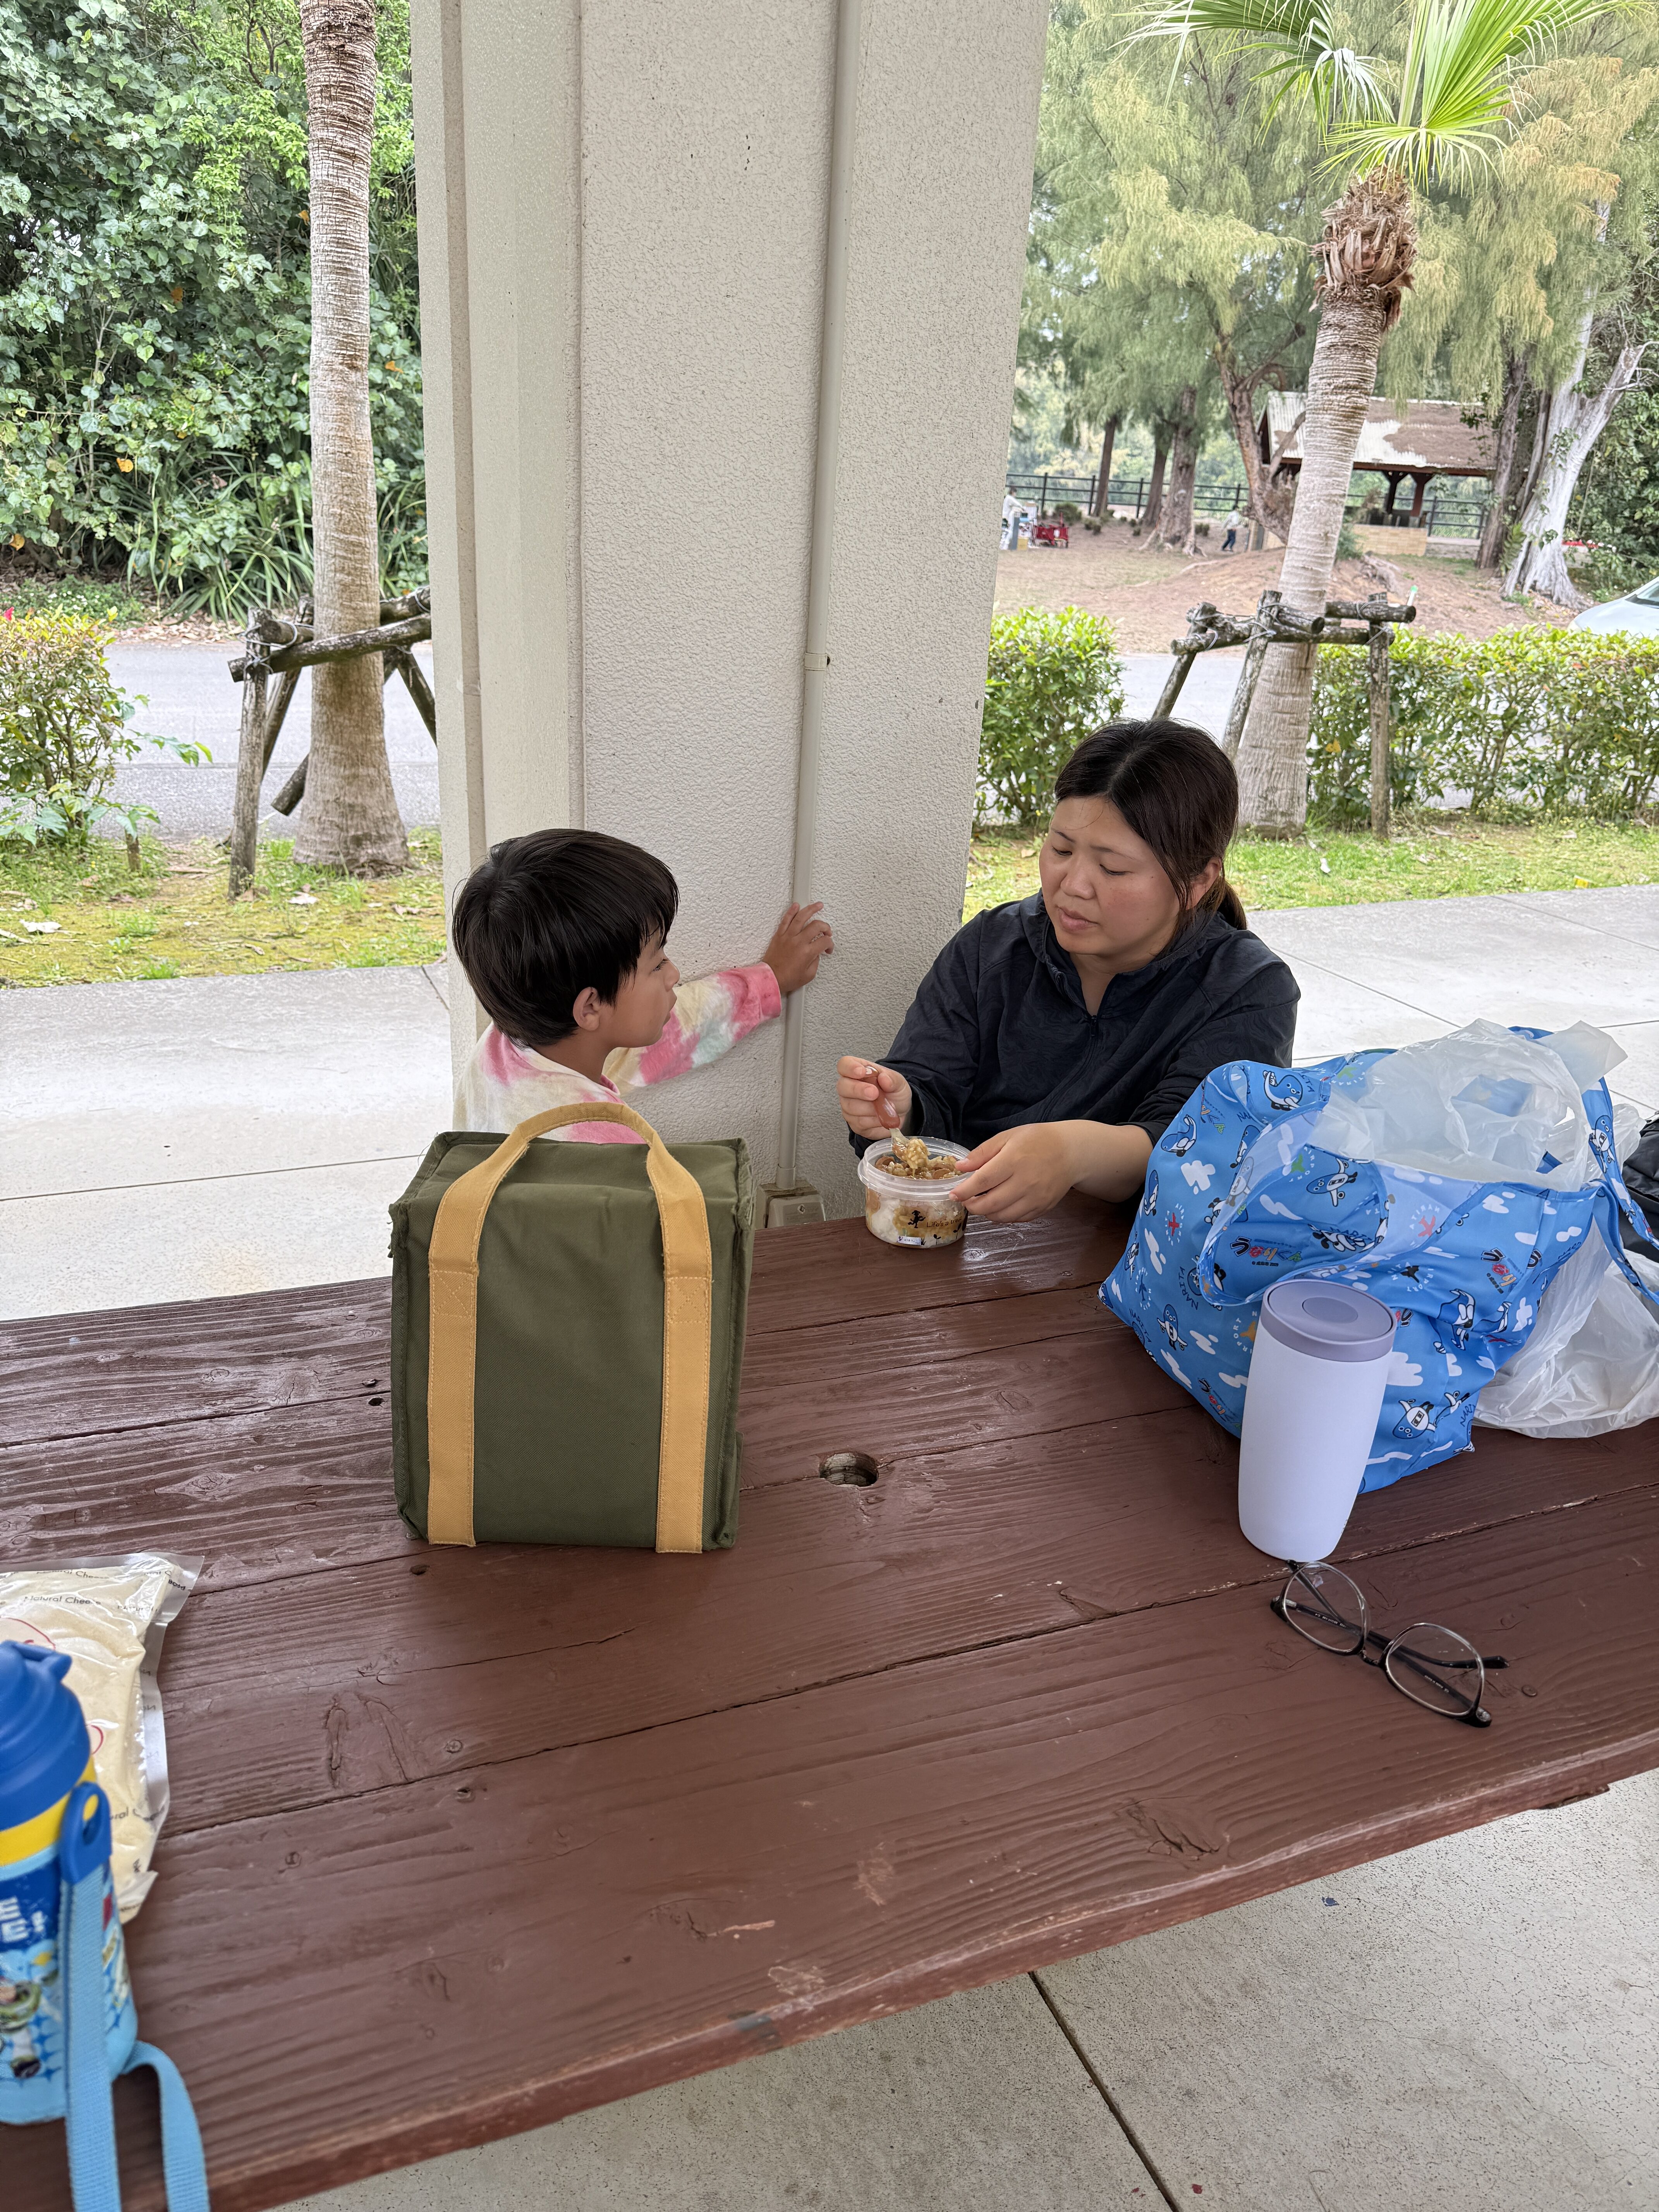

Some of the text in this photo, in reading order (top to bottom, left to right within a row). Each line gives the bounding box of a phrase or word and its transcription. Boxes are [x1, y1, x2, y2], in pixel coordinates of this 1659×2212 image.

[1289, 1146, 1315, 1183] AIRPORT
[1230, 1236, 1302, 1262] うなりくん
[1178, 1266, 1199, 1310] NARITA
[1233, 1318, 1252, 1354] IRPORT
